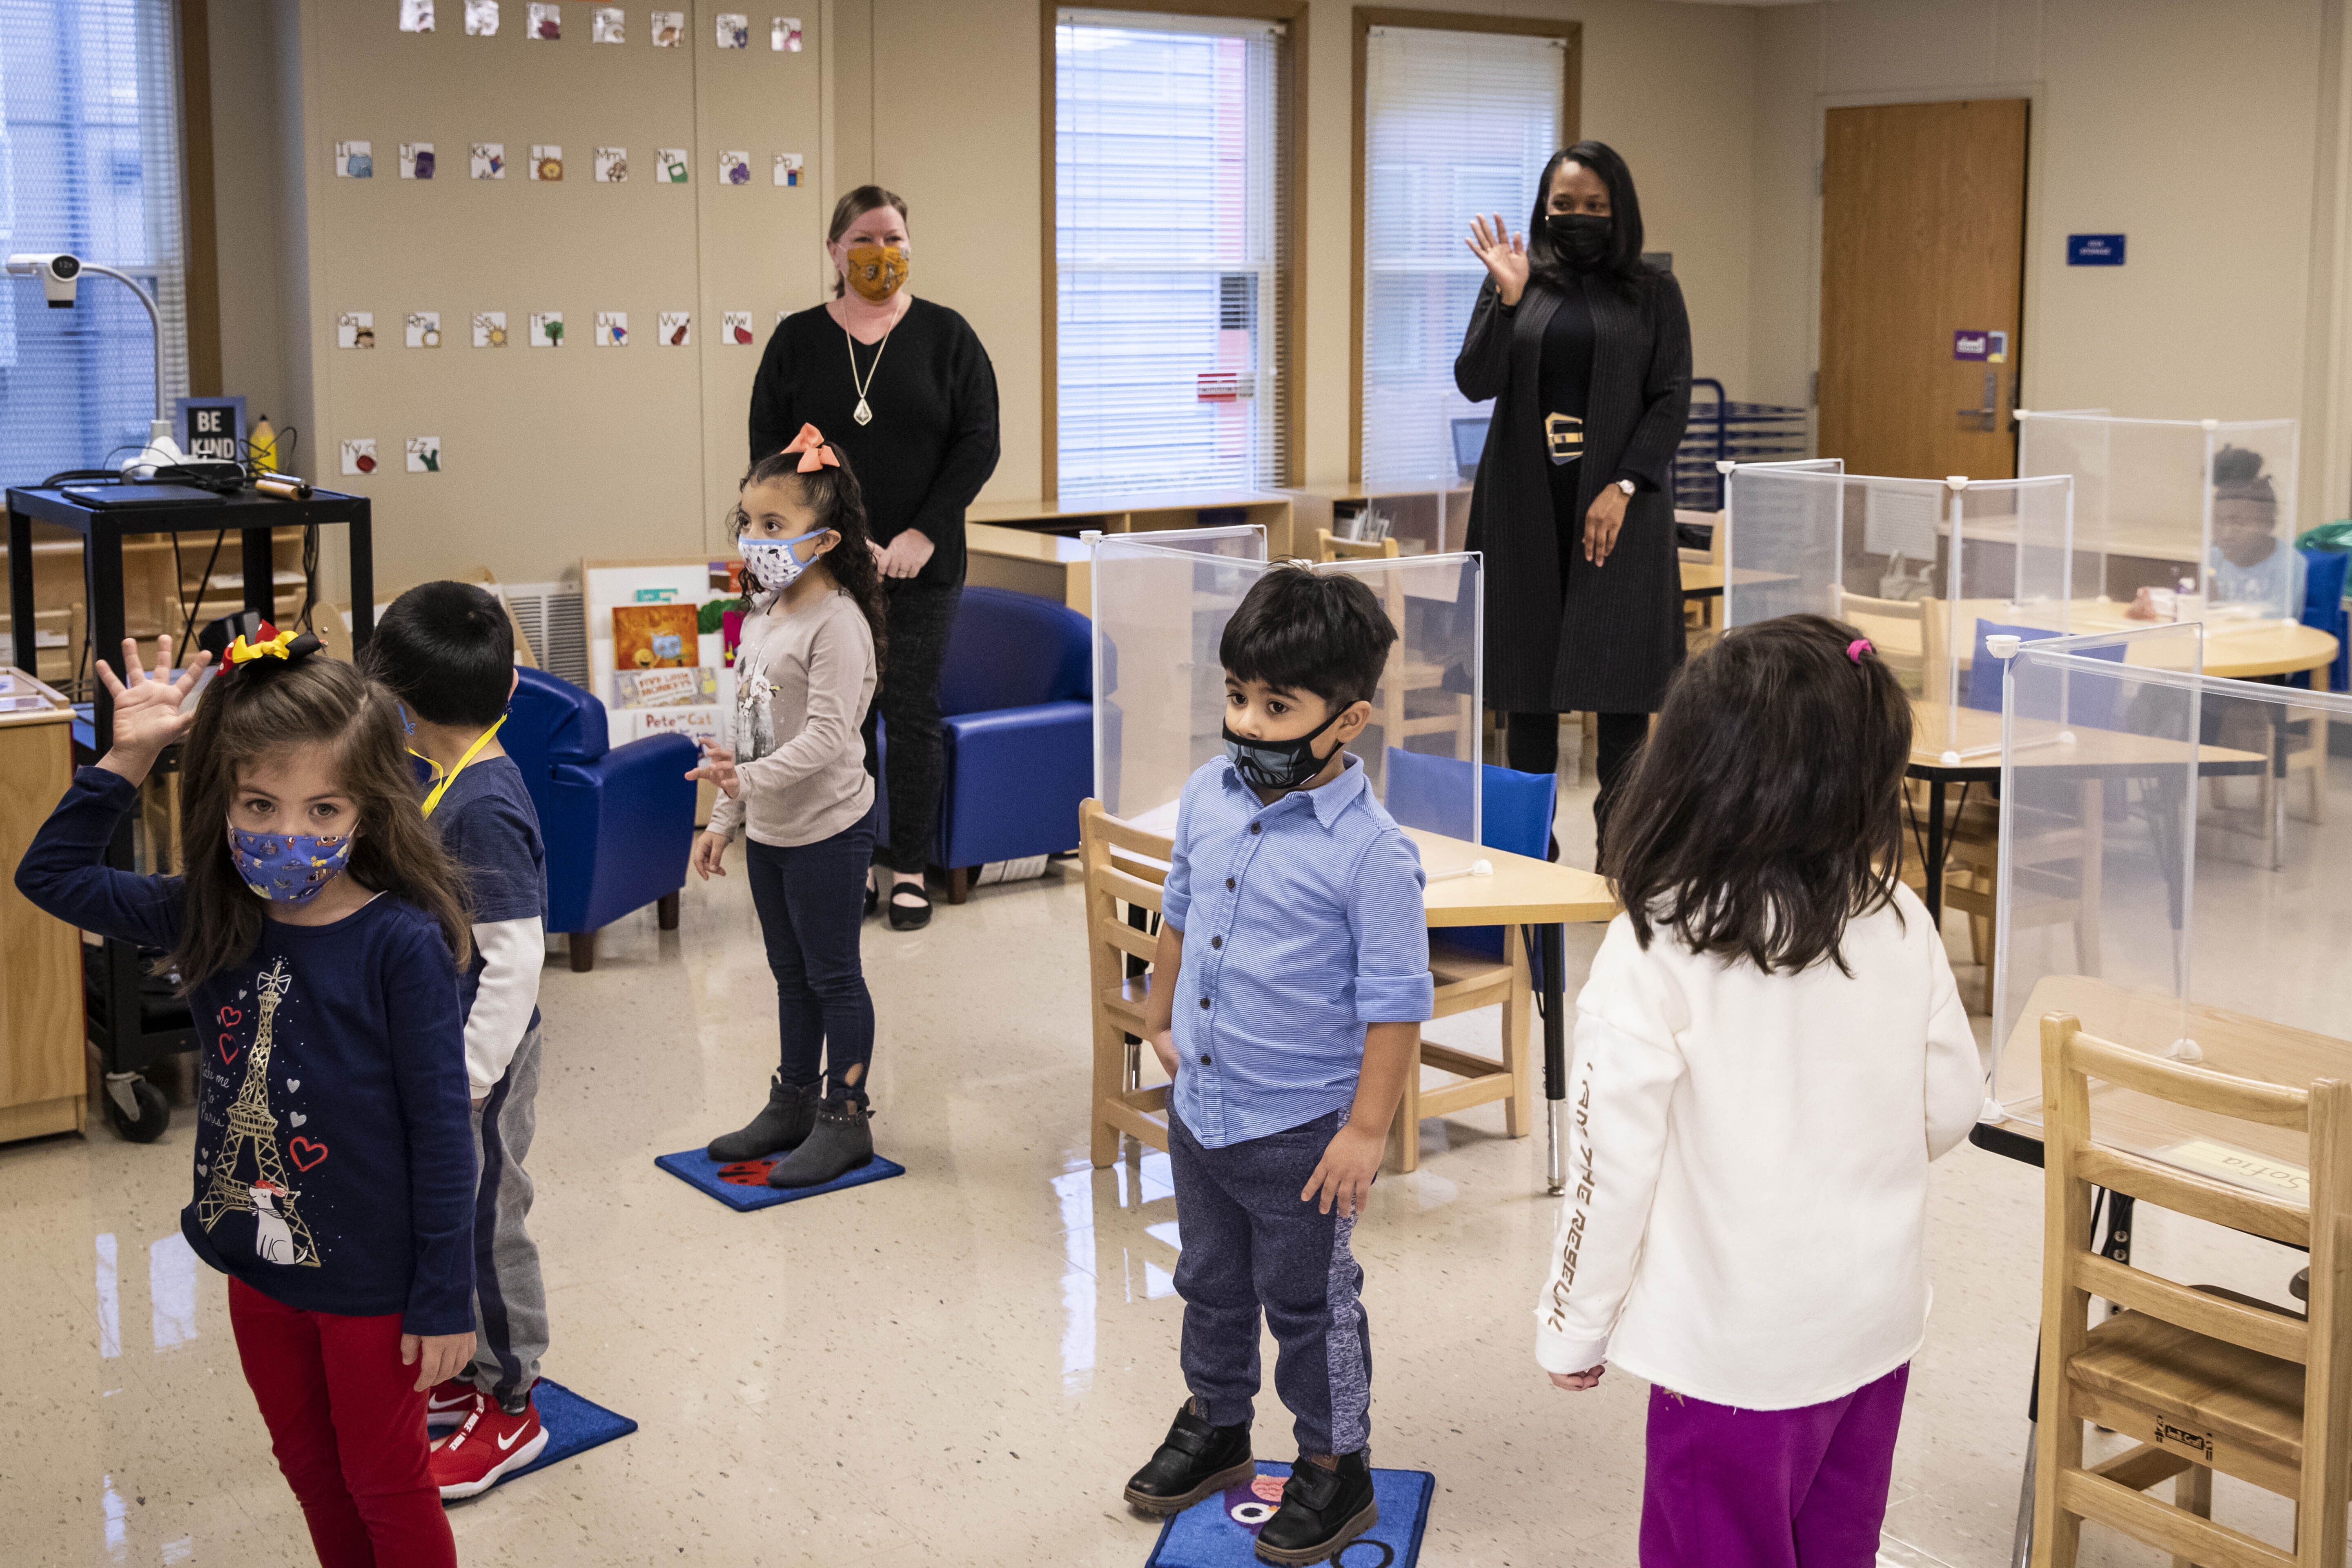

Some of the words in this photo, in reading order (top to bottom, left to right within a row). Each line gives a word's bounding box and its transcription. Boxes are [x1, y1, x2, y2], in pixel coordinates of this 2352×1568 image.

[721, 153, 739, 166] Oo
[660, 314, 679, 326] Vv
[724, 313, 747, 326] Ww
[197, 410, 222, 432] BE
[191, 438, 235, 459] KIND
[646, 714, 676, 727] Pete
[688, 713, 712, 726] Cat
[216, 1075, 229, 1088] me
[207, 1086, 215, 1103] to
[201, 1101, 225, 1127] Paris
[1577, 1143, 1595, 1205] THE
